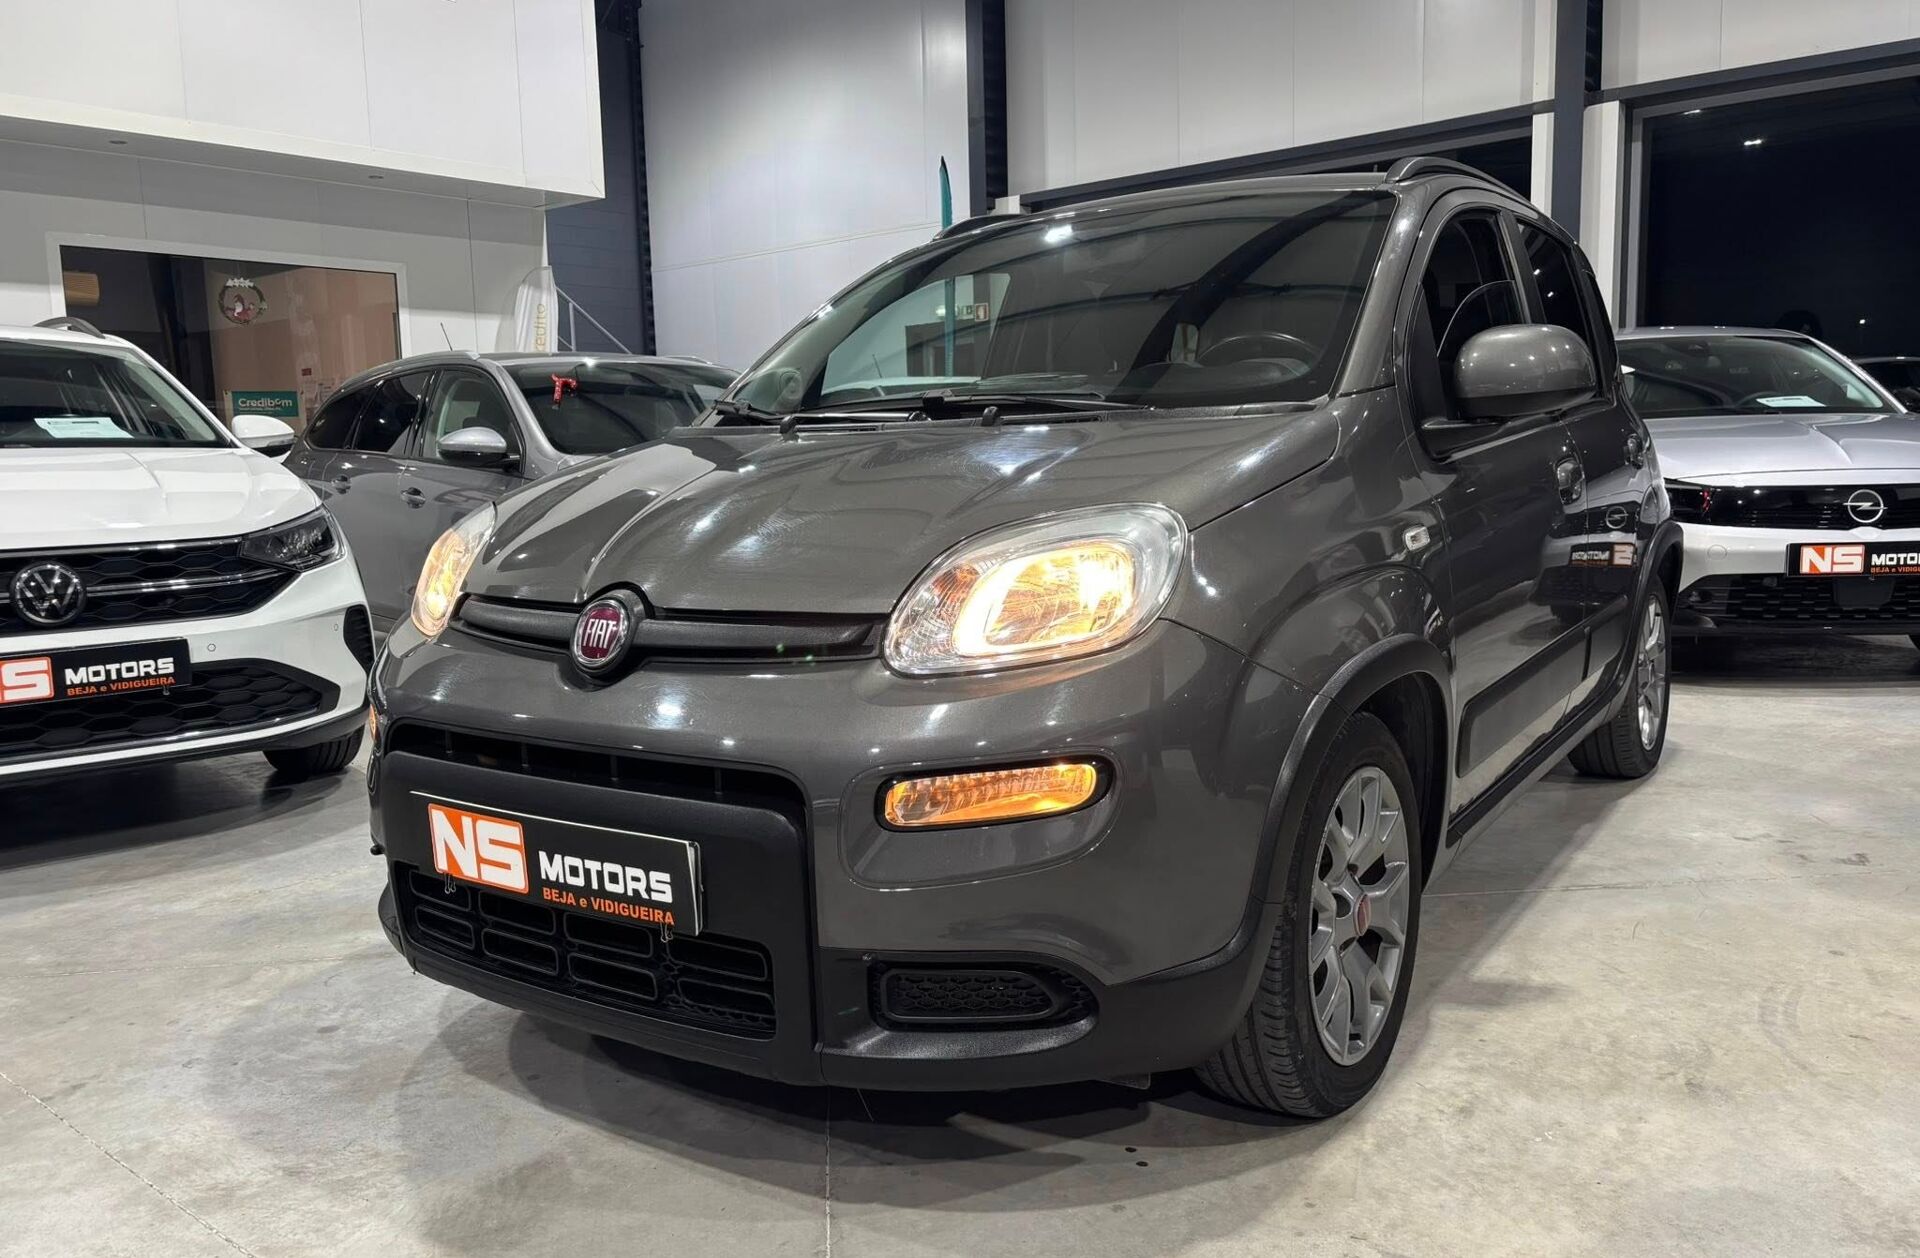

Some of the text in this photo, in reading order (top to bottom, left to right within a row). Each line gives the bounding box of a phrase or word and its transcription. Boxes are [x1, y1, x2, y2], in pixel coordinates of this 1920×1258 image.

[238, 397, 293, 407] Credibom
[1801, 546, 1920, 573] NS MOTO
[582, 618, 618, 649] FIAT
[64, 657, 175, 685] MOTORS
[66, 685, 97, 696] BEJA
[110, 676, 176, 691] VIDIGUEIRA
[431, 808, 673, 904] NS MOTORS
[542, 886, 675, 926] BEJA e VIDIGUEIRA
